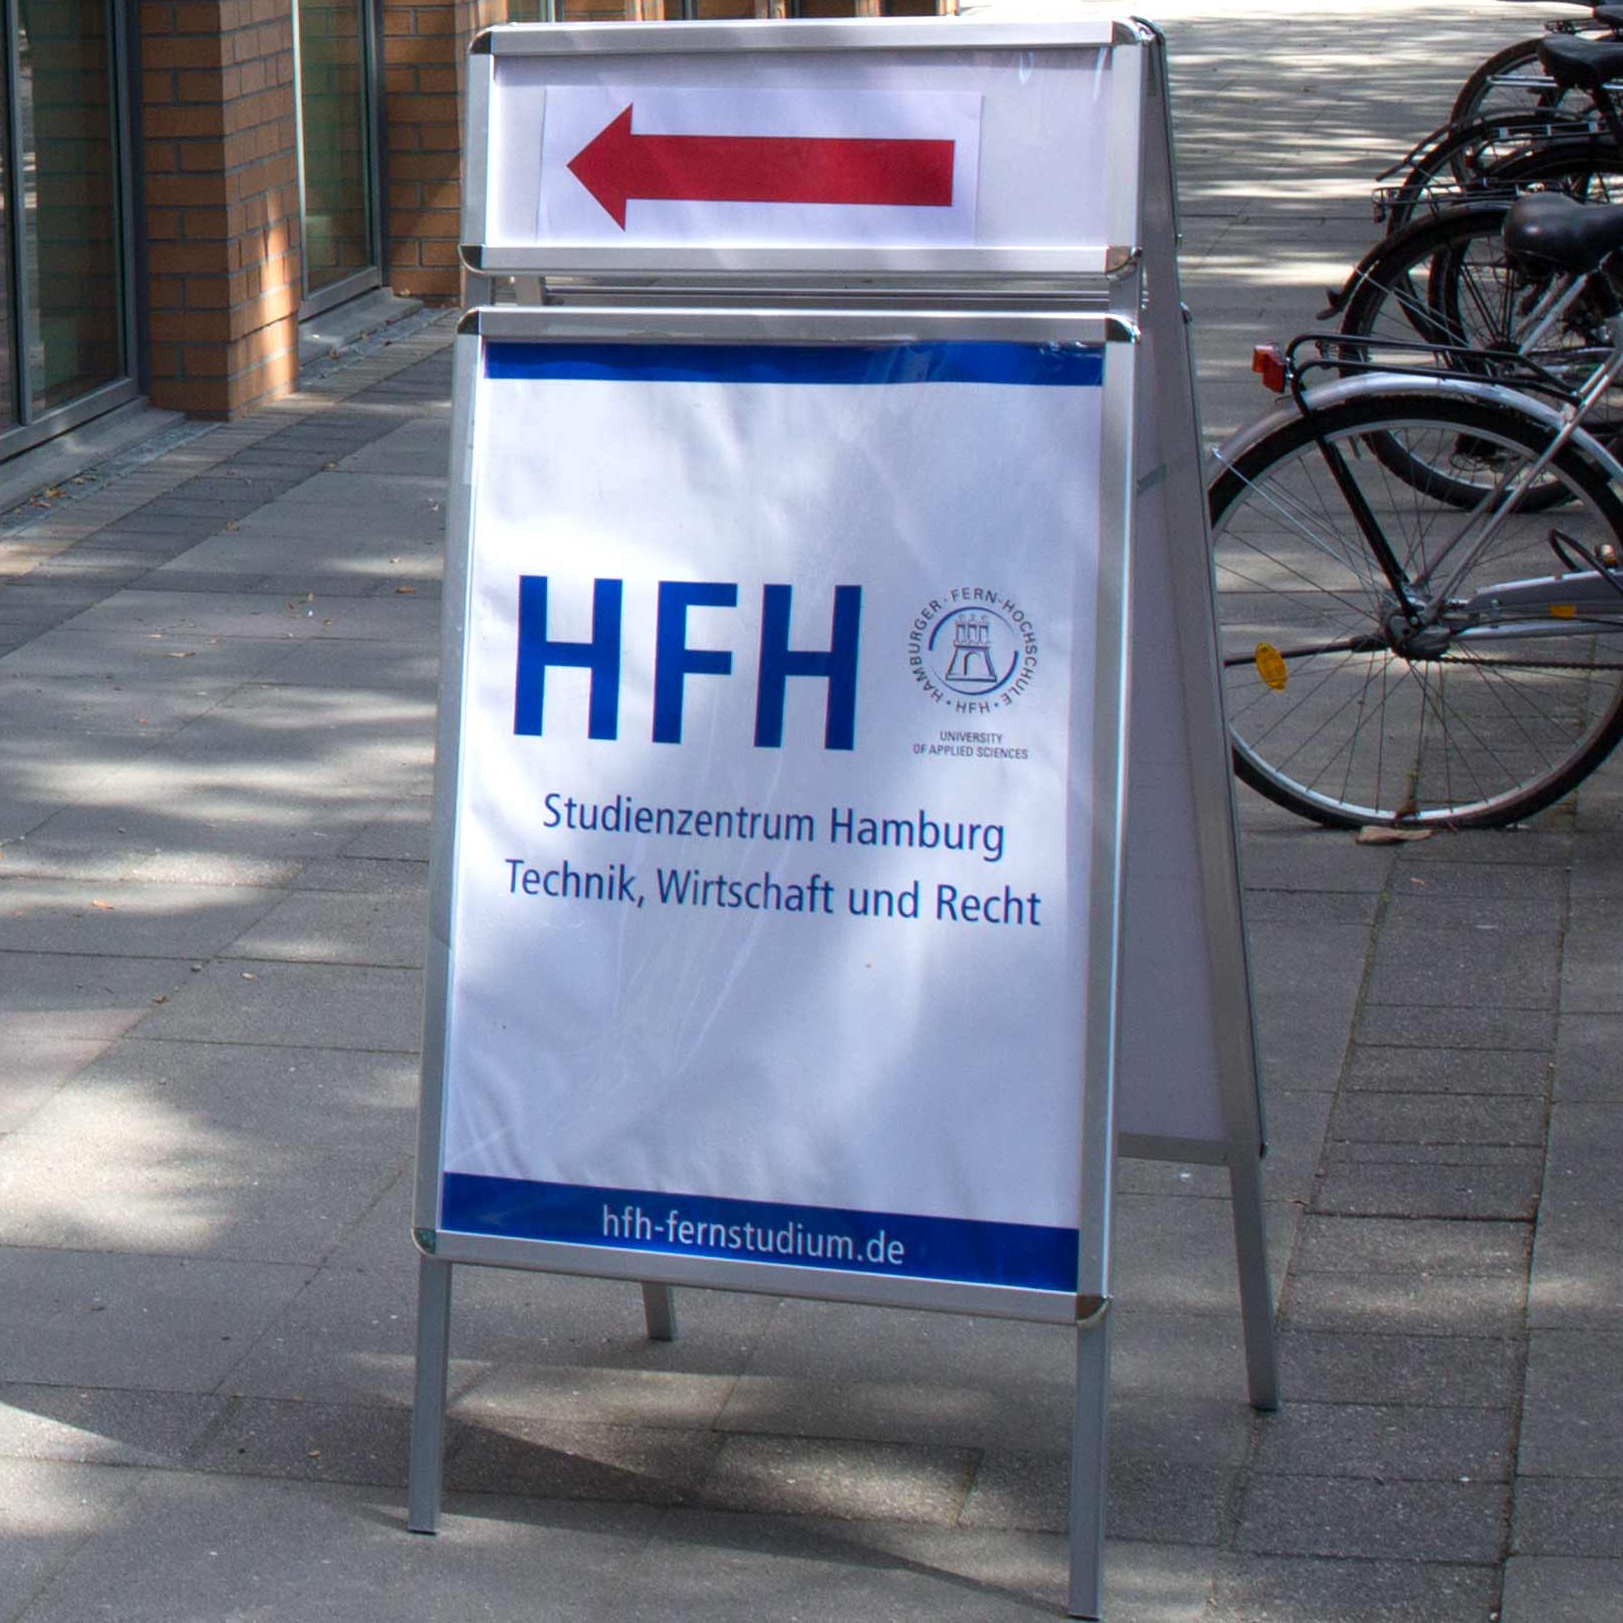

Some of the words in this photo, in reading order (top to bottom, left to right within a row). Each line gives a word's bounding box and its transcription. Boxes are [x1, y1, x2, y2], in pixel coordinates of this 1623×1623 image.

[514, 575, 863, 751] HFH
[908, 599, 944, 703] HAMBURGER
[951, 587, 1038, 706] FERN-HOCHSCHULE
[940, 731, 1003, 744] UNIVERSITY
[955, 701, 990, 714] HFH
[913, 743, 927, 755] OF
[929, 744, 973, 757] APPLIED
[976, 746, 1028, 759] SCIENCES
[543, 793, 815, 843] Studienzentrum
[830, 807, 1006, 862] Hamburg
[504, 858, 645, 910] Technik,
[656, 867, 833, 916] Wirtschaft
[848, 880, 920, 920] und
[935, 884, 1042, 927] Recht
[602, 1205, 905, 1264] hfh-fernstudium.de
